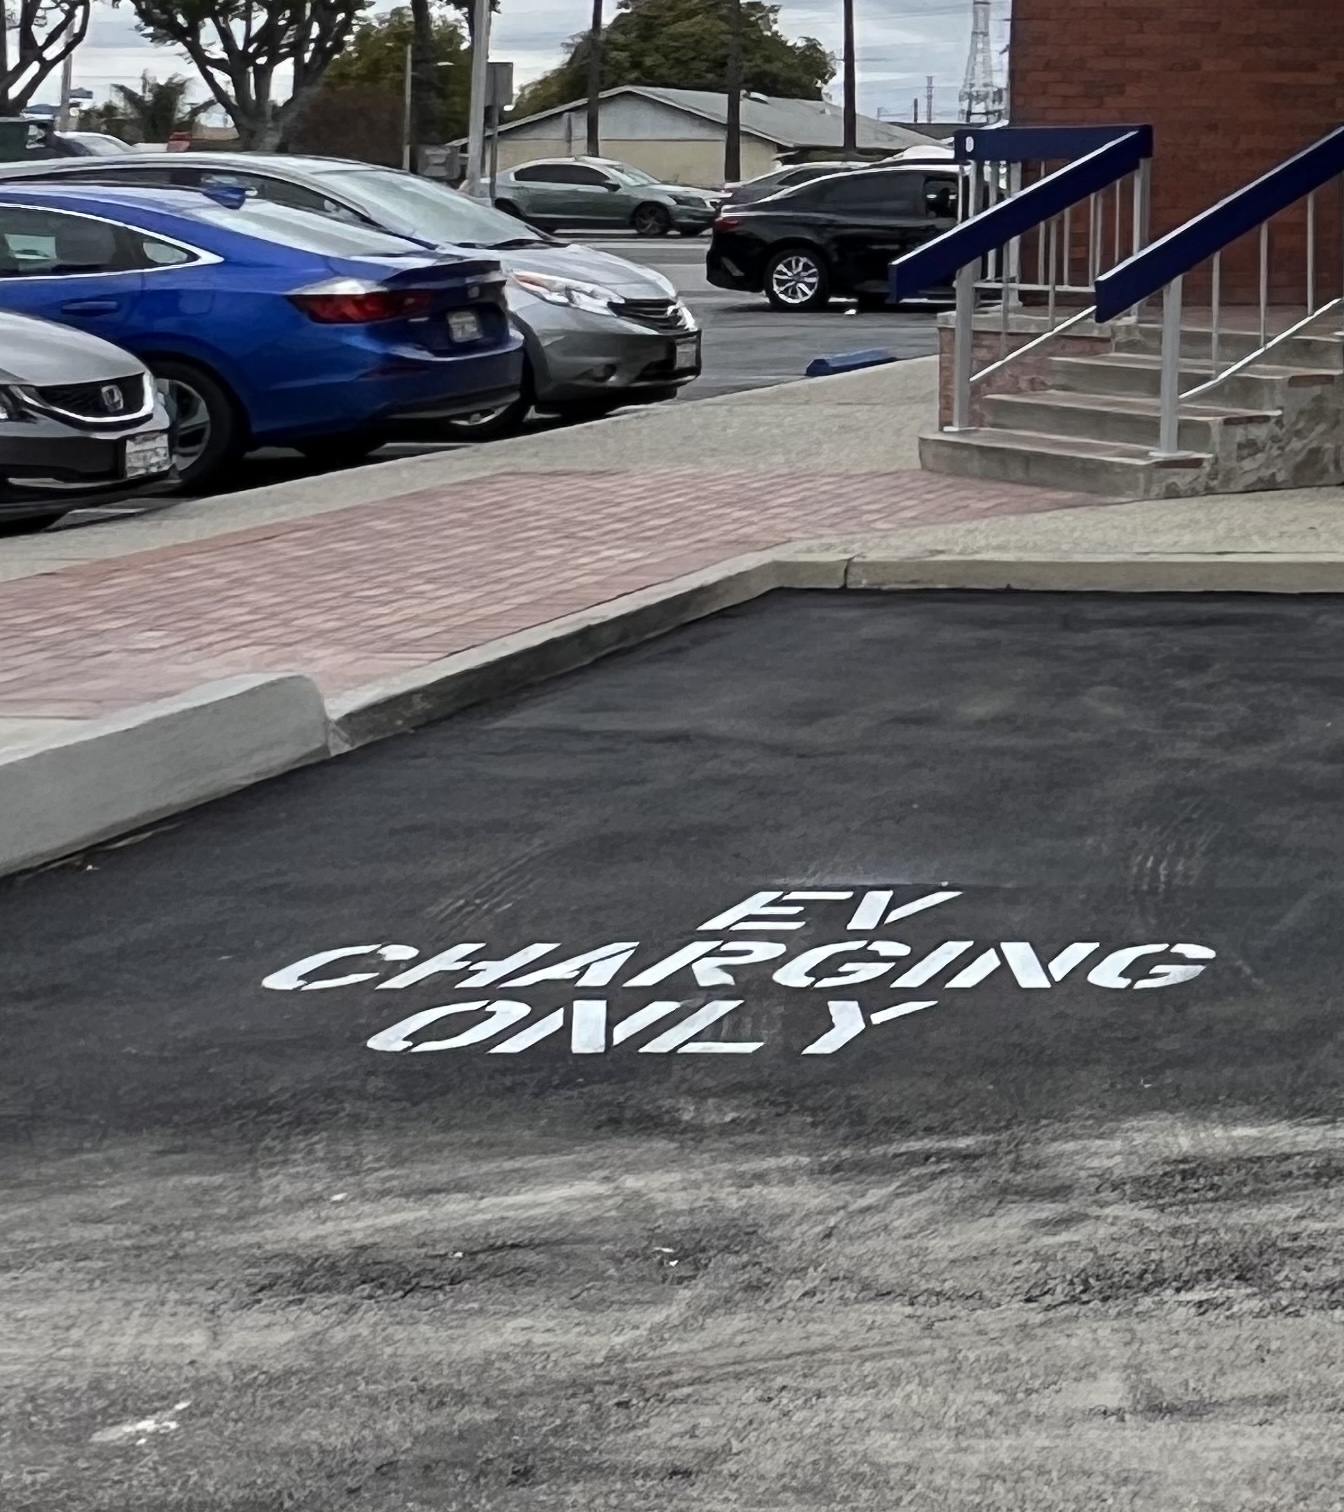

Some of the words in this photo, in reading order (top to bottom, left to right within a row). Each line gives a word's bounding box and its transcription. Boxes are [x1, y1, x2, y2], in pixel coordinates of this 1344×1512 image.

[696, 890, 963, 931] EV
[260, 939, 1217, 990] CHARGING
[364, 999, 939, 1055] ONLY
